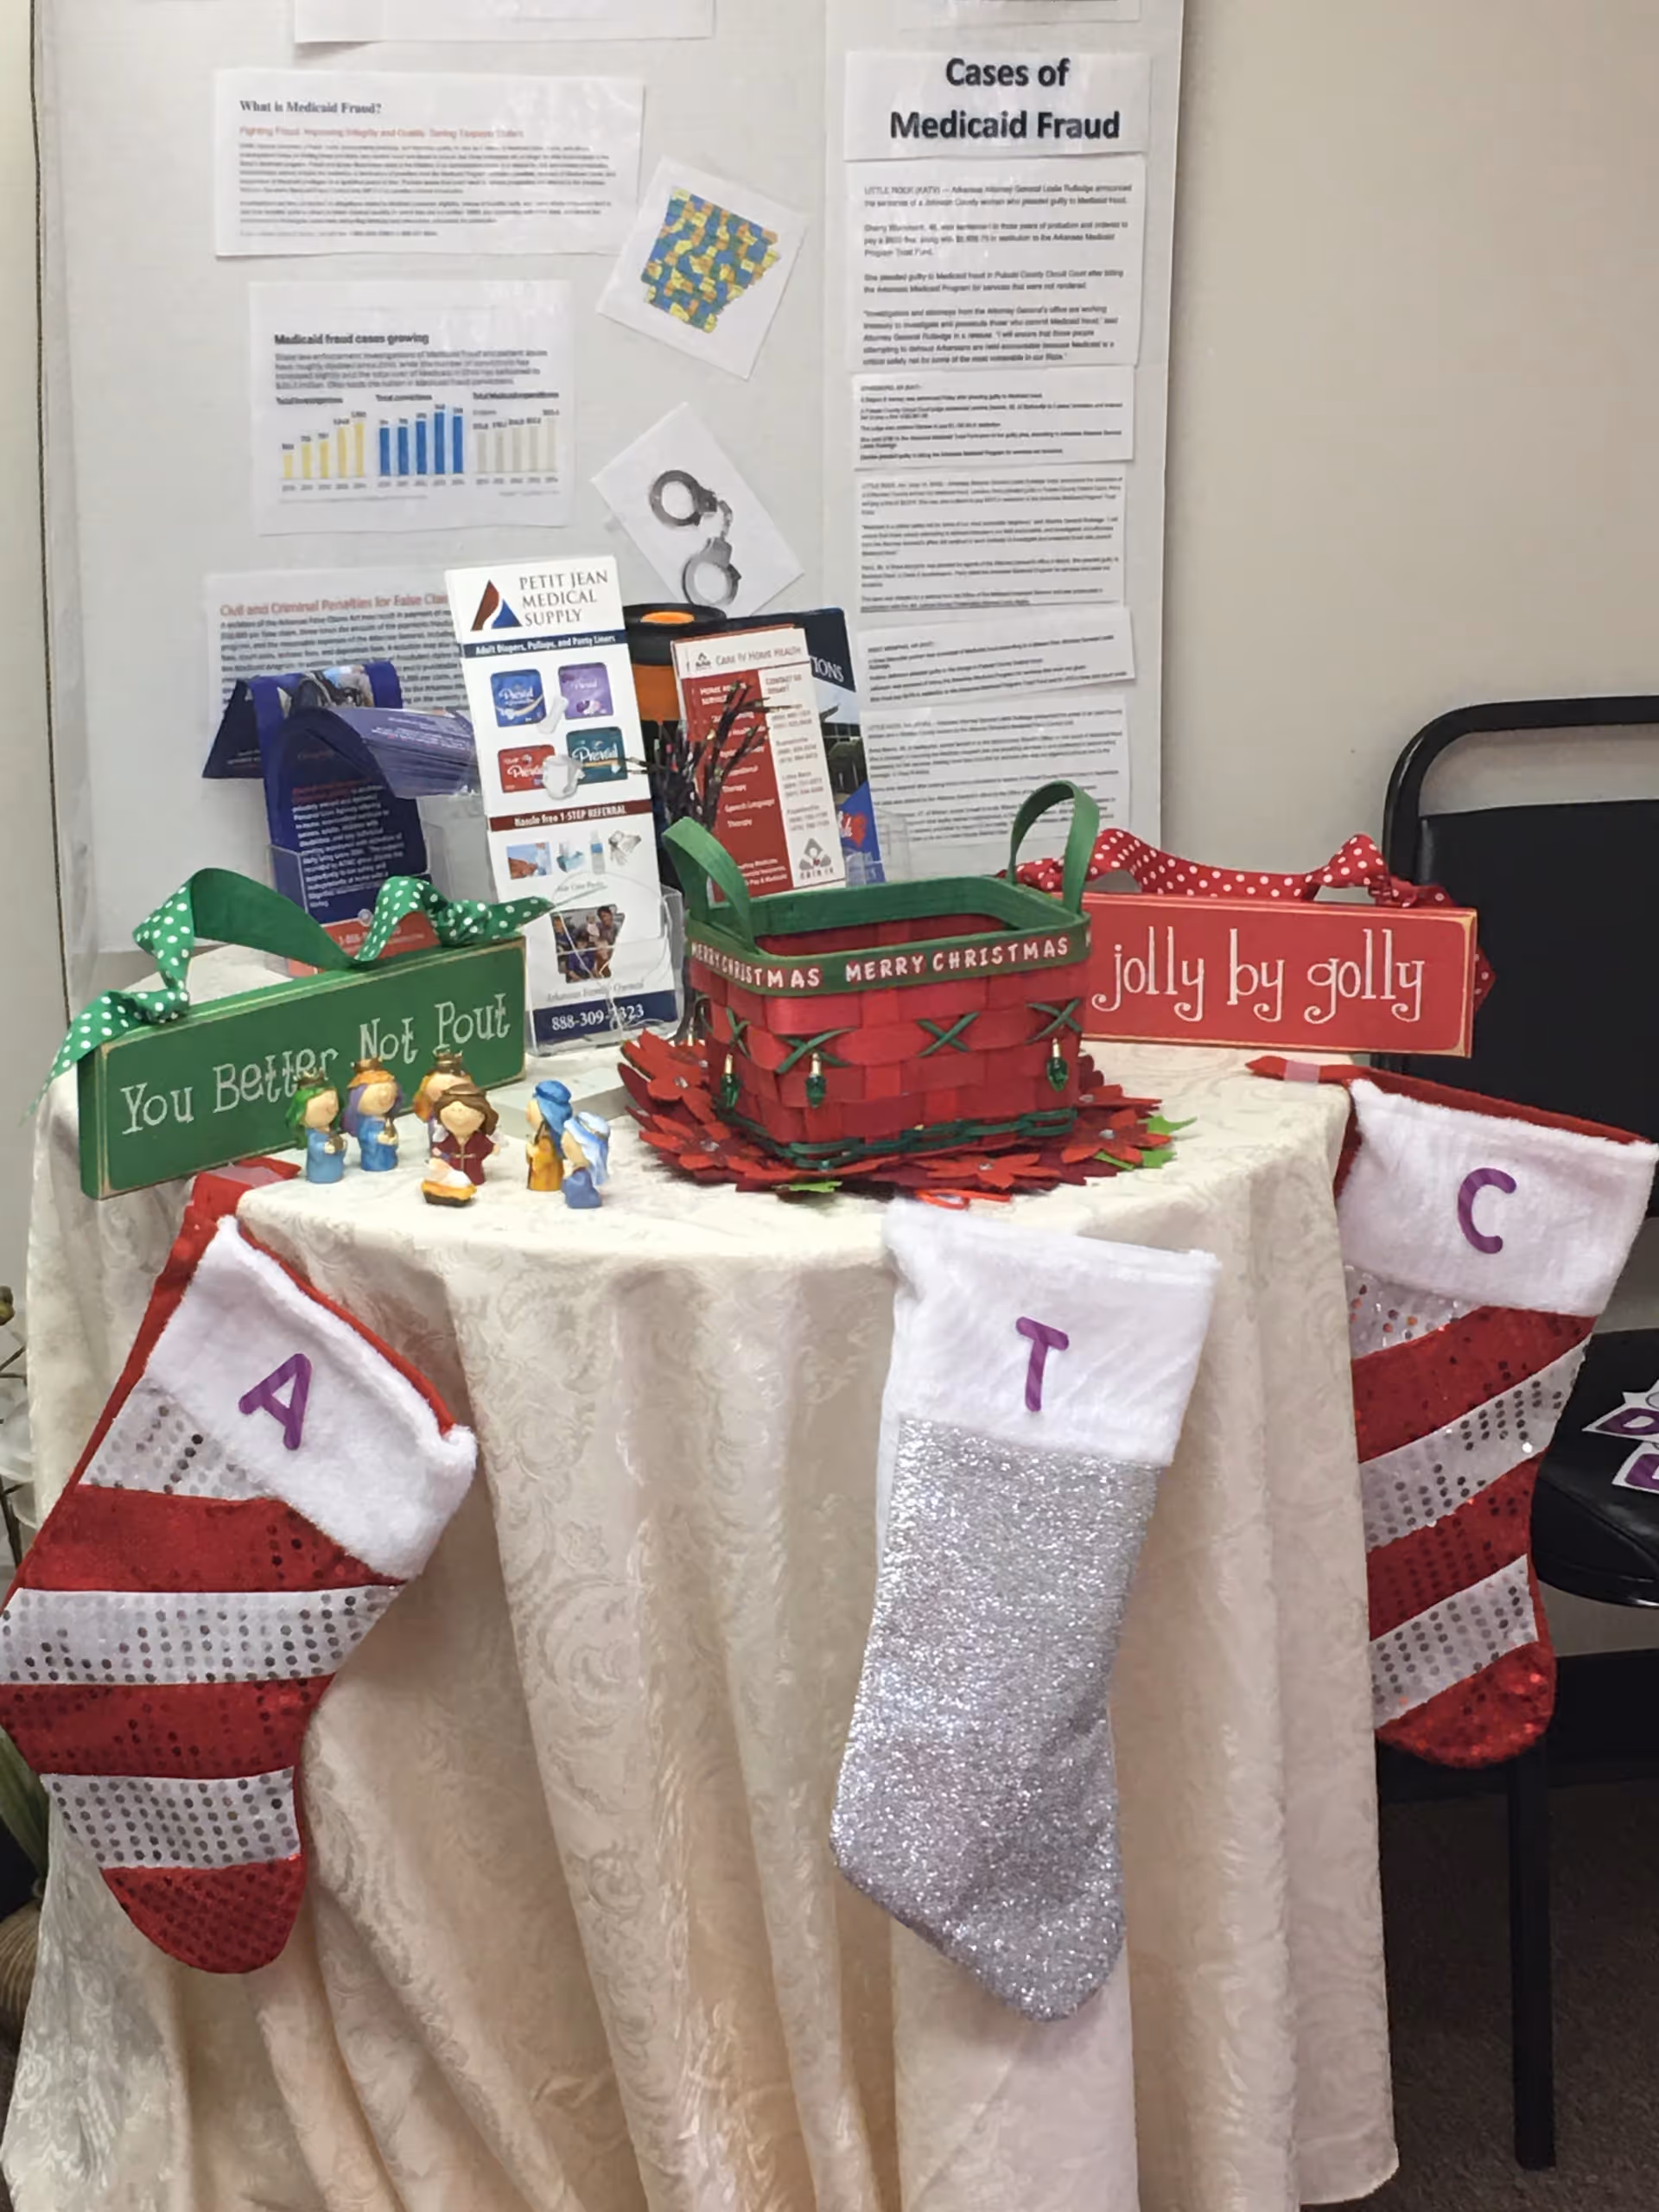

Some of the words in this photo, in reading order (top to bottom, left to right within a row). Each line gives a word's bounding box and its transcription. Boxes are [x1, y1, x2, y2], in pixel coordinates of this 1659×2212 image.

[946, 57, 1029, 86] Cases
[1037, 57, 1070, 86] of
[239, 100, 271, 112] What
[275, 101, 283, 112] is
[286, 101, 337, 113] Medicaid
[340, 102, 382, 114] Fraud?
[890, 110, 1027, 139] Medicaid
[1037, 111, 1120, 139] Fraud
[274, 334, 323, 345] Medicaid
[326, 334, 353, 344] fraud
[355, 335, 385, 344] cases
[387, 334, 429, 346] growing
[519, 574, 565, 591] PETIT
[570, 569, 608, 587] JEAN
[220, 604, 244, 616] Civil
[247, 606, 269, 615] and
[271, 601, 319, 613] Criminal
[321, 598, 372, 610] Penalties
[375, 596, 390, 607] for
[394, 594, 422, 606] False
[522, 589, 598, 610] MEDICAL
[524, 608, 582, 627] SUPPLY
[475, 645, 496, 656] Adult
[497, 644, 527, 654] Diapers,
[527, 640, 556, 651] Pullups,
[557, 638, 571, 647] and
[572, 637, 593, 647] Panty
[594, 635, 616, 644] Liners
[572, 742, 618, 763] Prevail
[514, 815, 541, 828] Hassle
[542, 813, 558, 825] free
[559, 809, 587, 822] 1-STEP
[721, 954, 820, 988] CHRISTMAS
[845, 954, 923, 983] MERRY
[931, 937, 1069, 972] CHRISTMAS
[1091, 925, 1205, 1022] jolly
[1227, 928, 1285, 1022] by
[1303, 928, 1425, 1025] golly
[120, 1081, 194, 1135] You
[213, 1047, 339, 1114] Better
[359, 1016, 418, 1065] Not
[434, 992, 512, 1054] Pout
[1458, 1167, 1516, 1254] C
[1016, 1316, 1069, 1412] T
[238, 1353, 312, 1451] A
